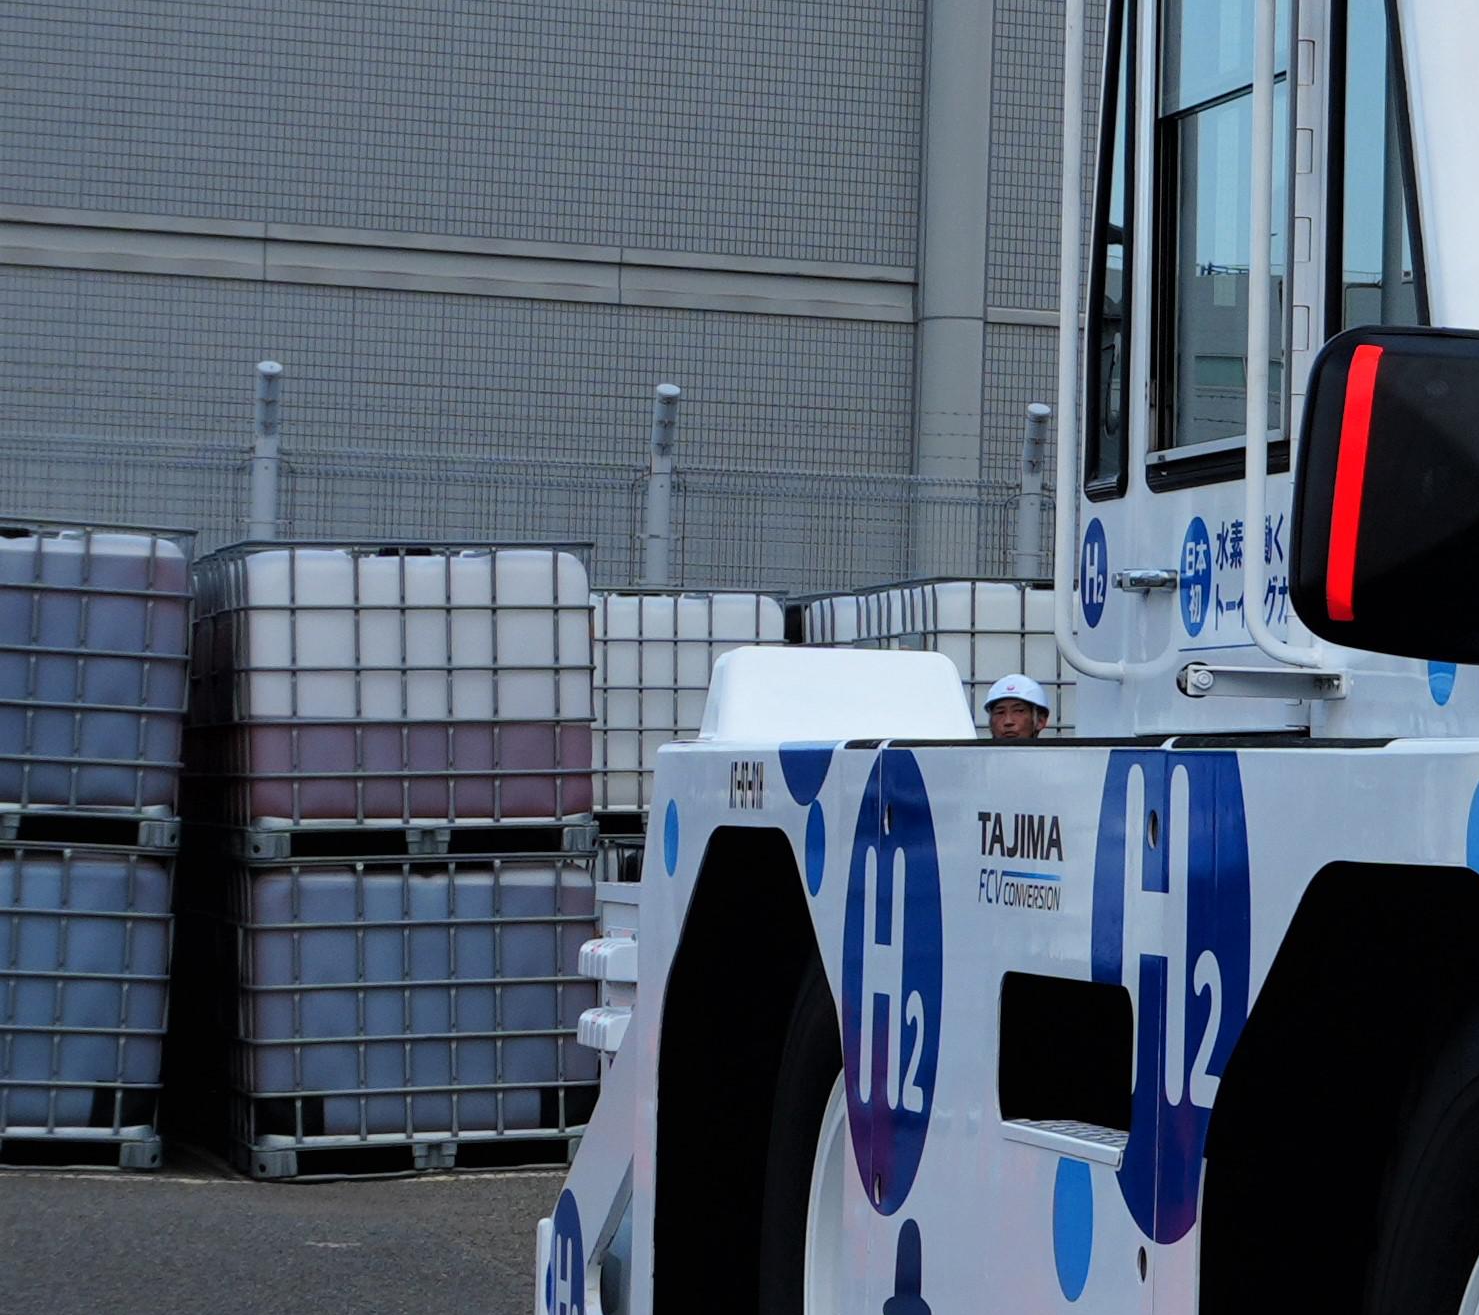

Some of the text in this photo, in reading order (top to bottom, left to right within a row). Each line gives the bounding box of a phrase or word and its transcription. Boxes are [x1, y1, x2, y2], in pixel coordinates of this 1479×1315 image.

[1186, 539, 1208, 575] 日本
[1190, 584, 1202, 623] 初
[978, 811, 1063, 861] TAJIMA
[978, 868, 1061, 911] FCV CONVERSION
[859, 846, 925, 1114] H2
